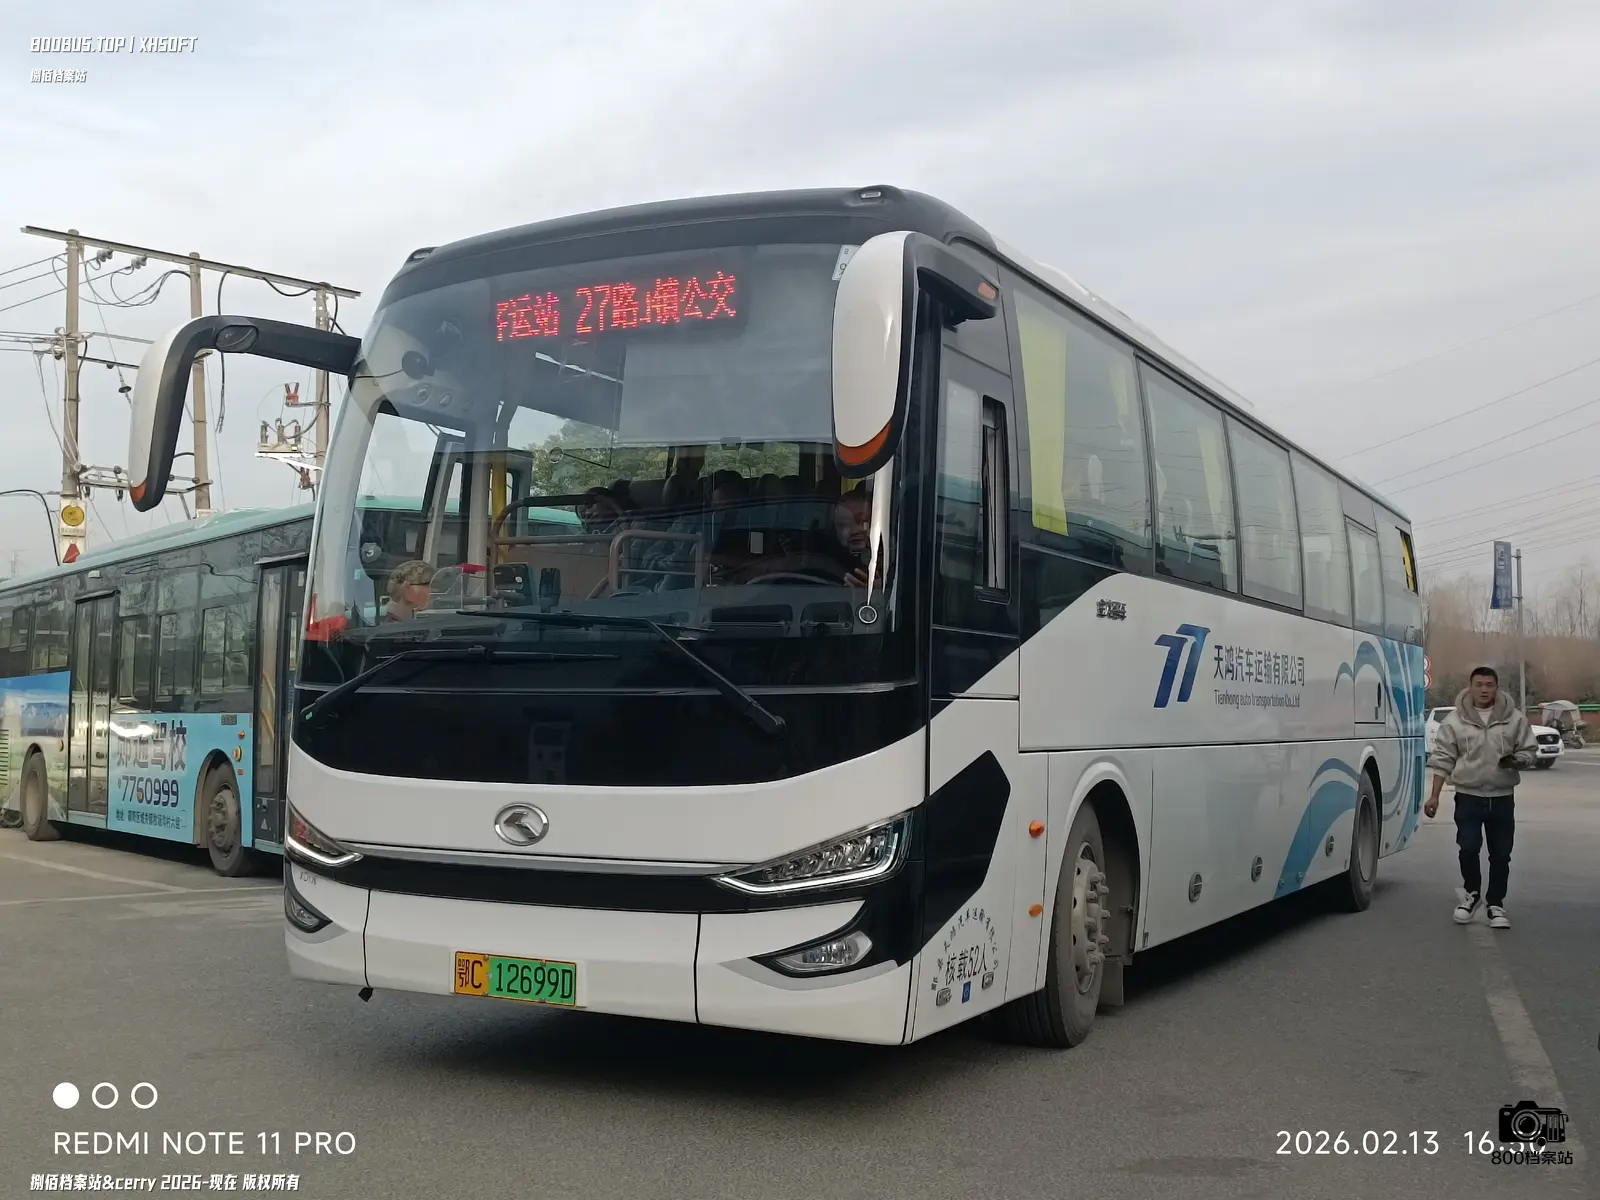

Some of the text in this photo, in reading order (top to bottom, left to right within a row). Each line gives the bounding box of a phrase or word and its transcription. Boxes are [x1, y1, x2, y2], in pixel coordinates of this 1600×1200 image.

[1213, 644, 1305, 687] 天鸿汽车运输有限公司
[1214, 689, 1239, 709] Tianhong
[121, 775, 179, 807] 7760999
[457, 958, 573, 999] 鄂C 12699D
[944, 942, 987, 987] 核载52人
